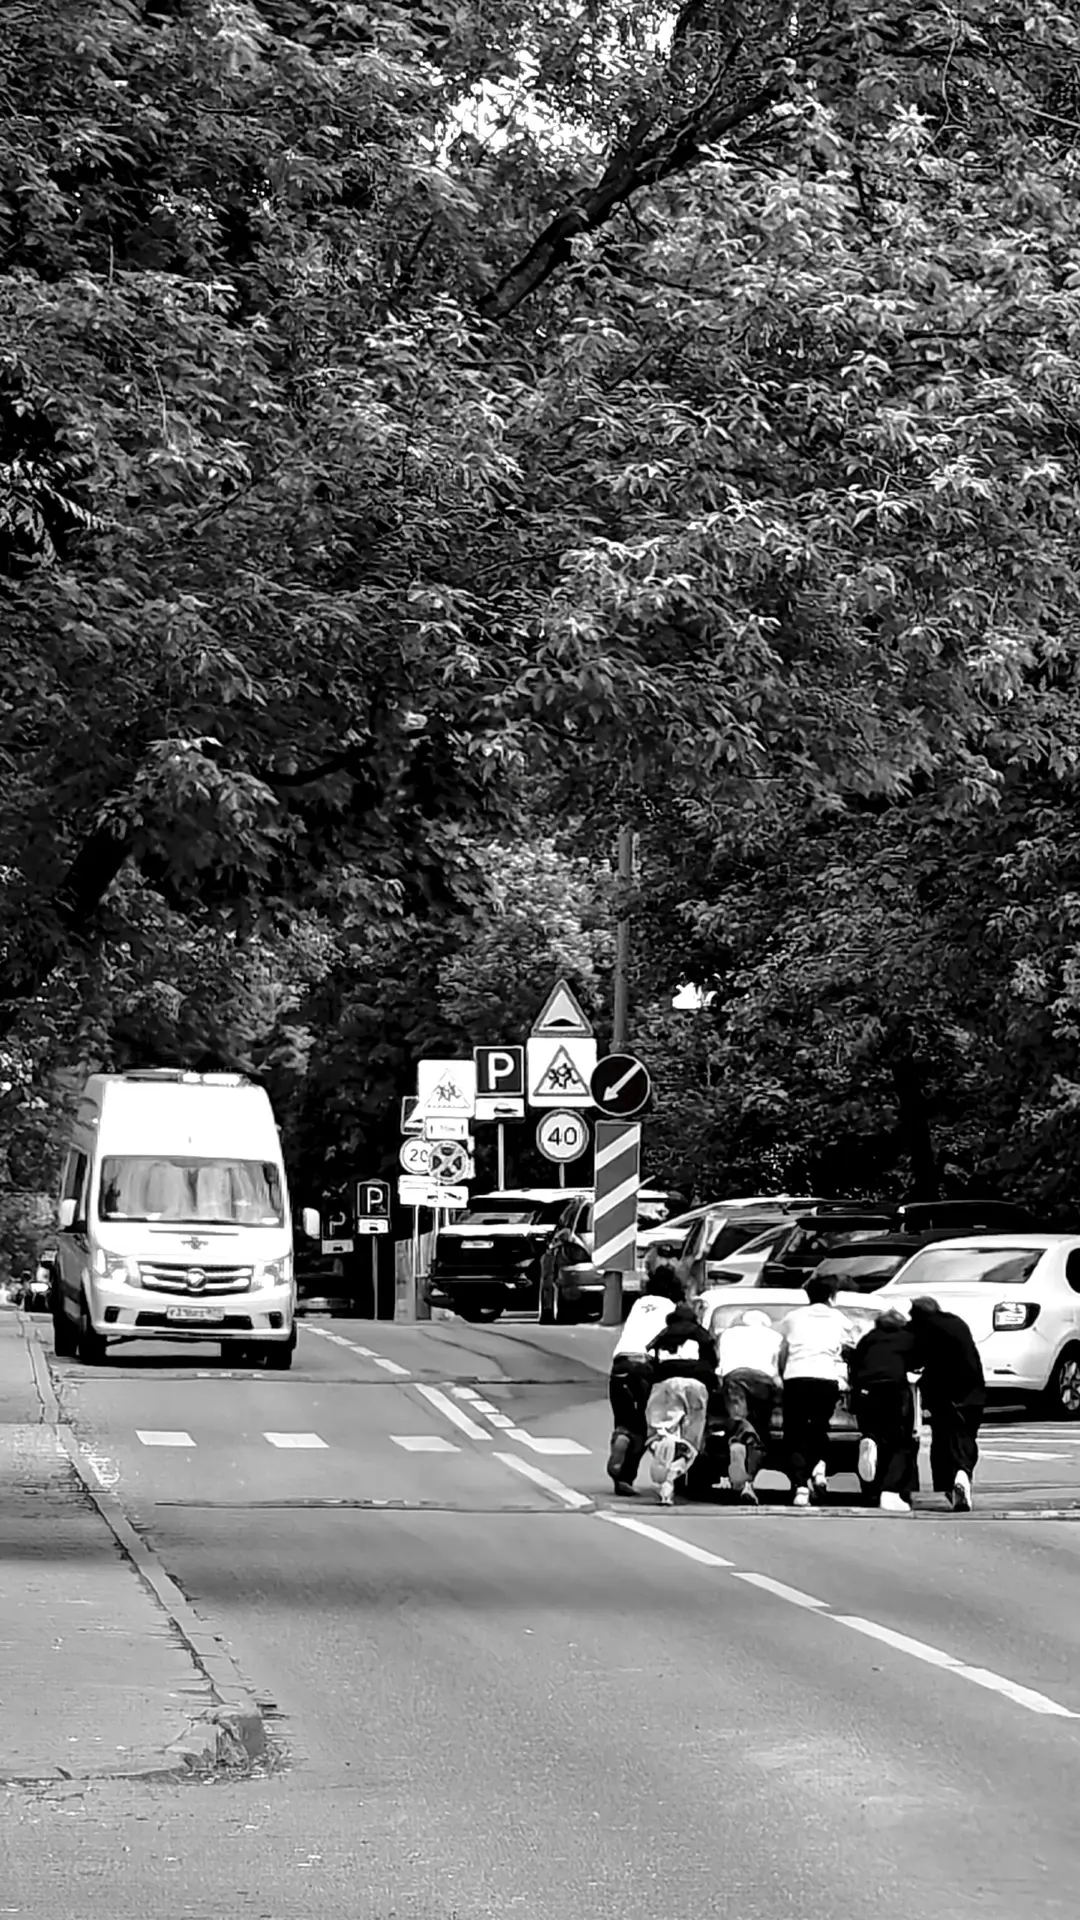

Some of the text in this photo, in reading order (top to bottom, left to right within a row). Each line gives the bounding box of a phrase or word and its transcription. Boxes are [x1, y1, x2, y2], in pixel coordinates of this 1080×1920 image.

[487, 1051, 515, 1090] P
[547, 1127, 577, 1146] 40
[366, 1186, 383, 1213] P
